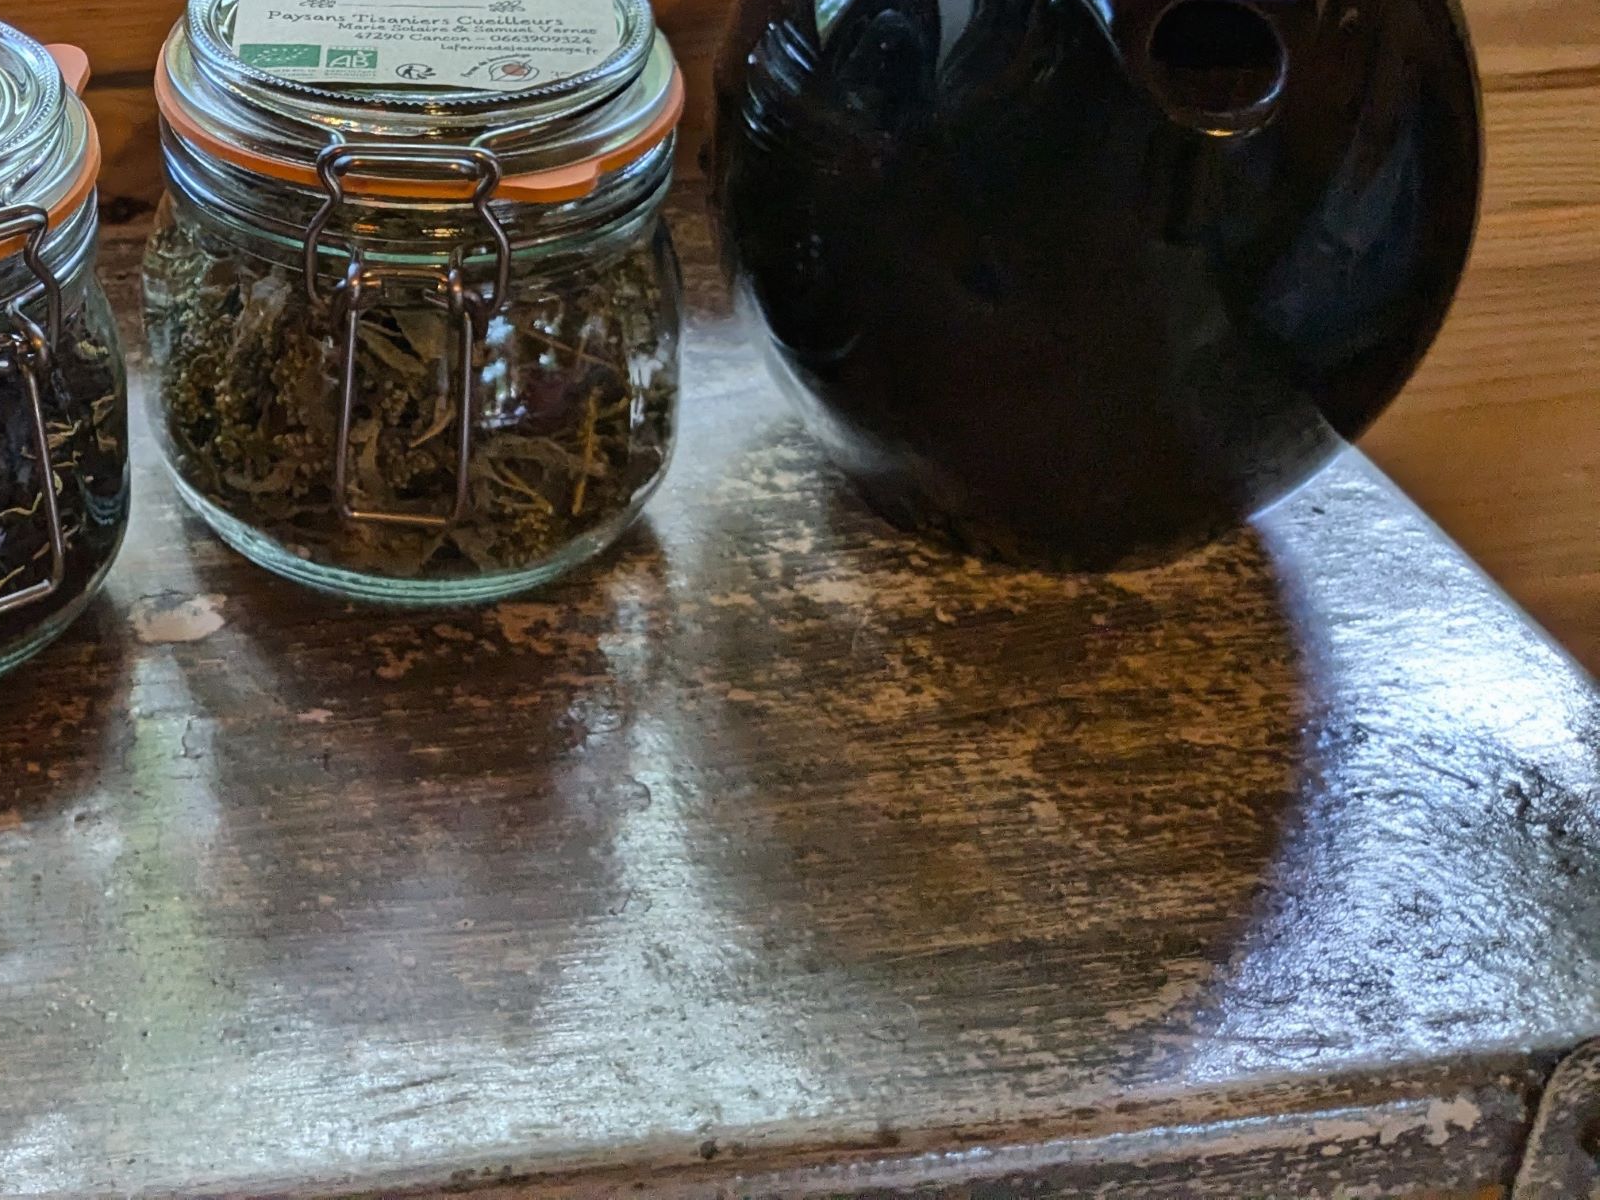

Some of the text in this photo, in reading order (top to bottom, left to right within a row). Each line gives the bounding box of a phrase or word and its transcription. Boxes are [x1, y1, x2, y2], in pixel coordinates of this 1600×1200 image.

[267, 9, 564, 26] Paysans Tisaniers Cueilleurs
[338, 22, 387, 31] Marie
[473, 25, 534, 34] Samuel
[354, 32, 404, 41] 47290
[409, 32, 472, 42] Cancon
